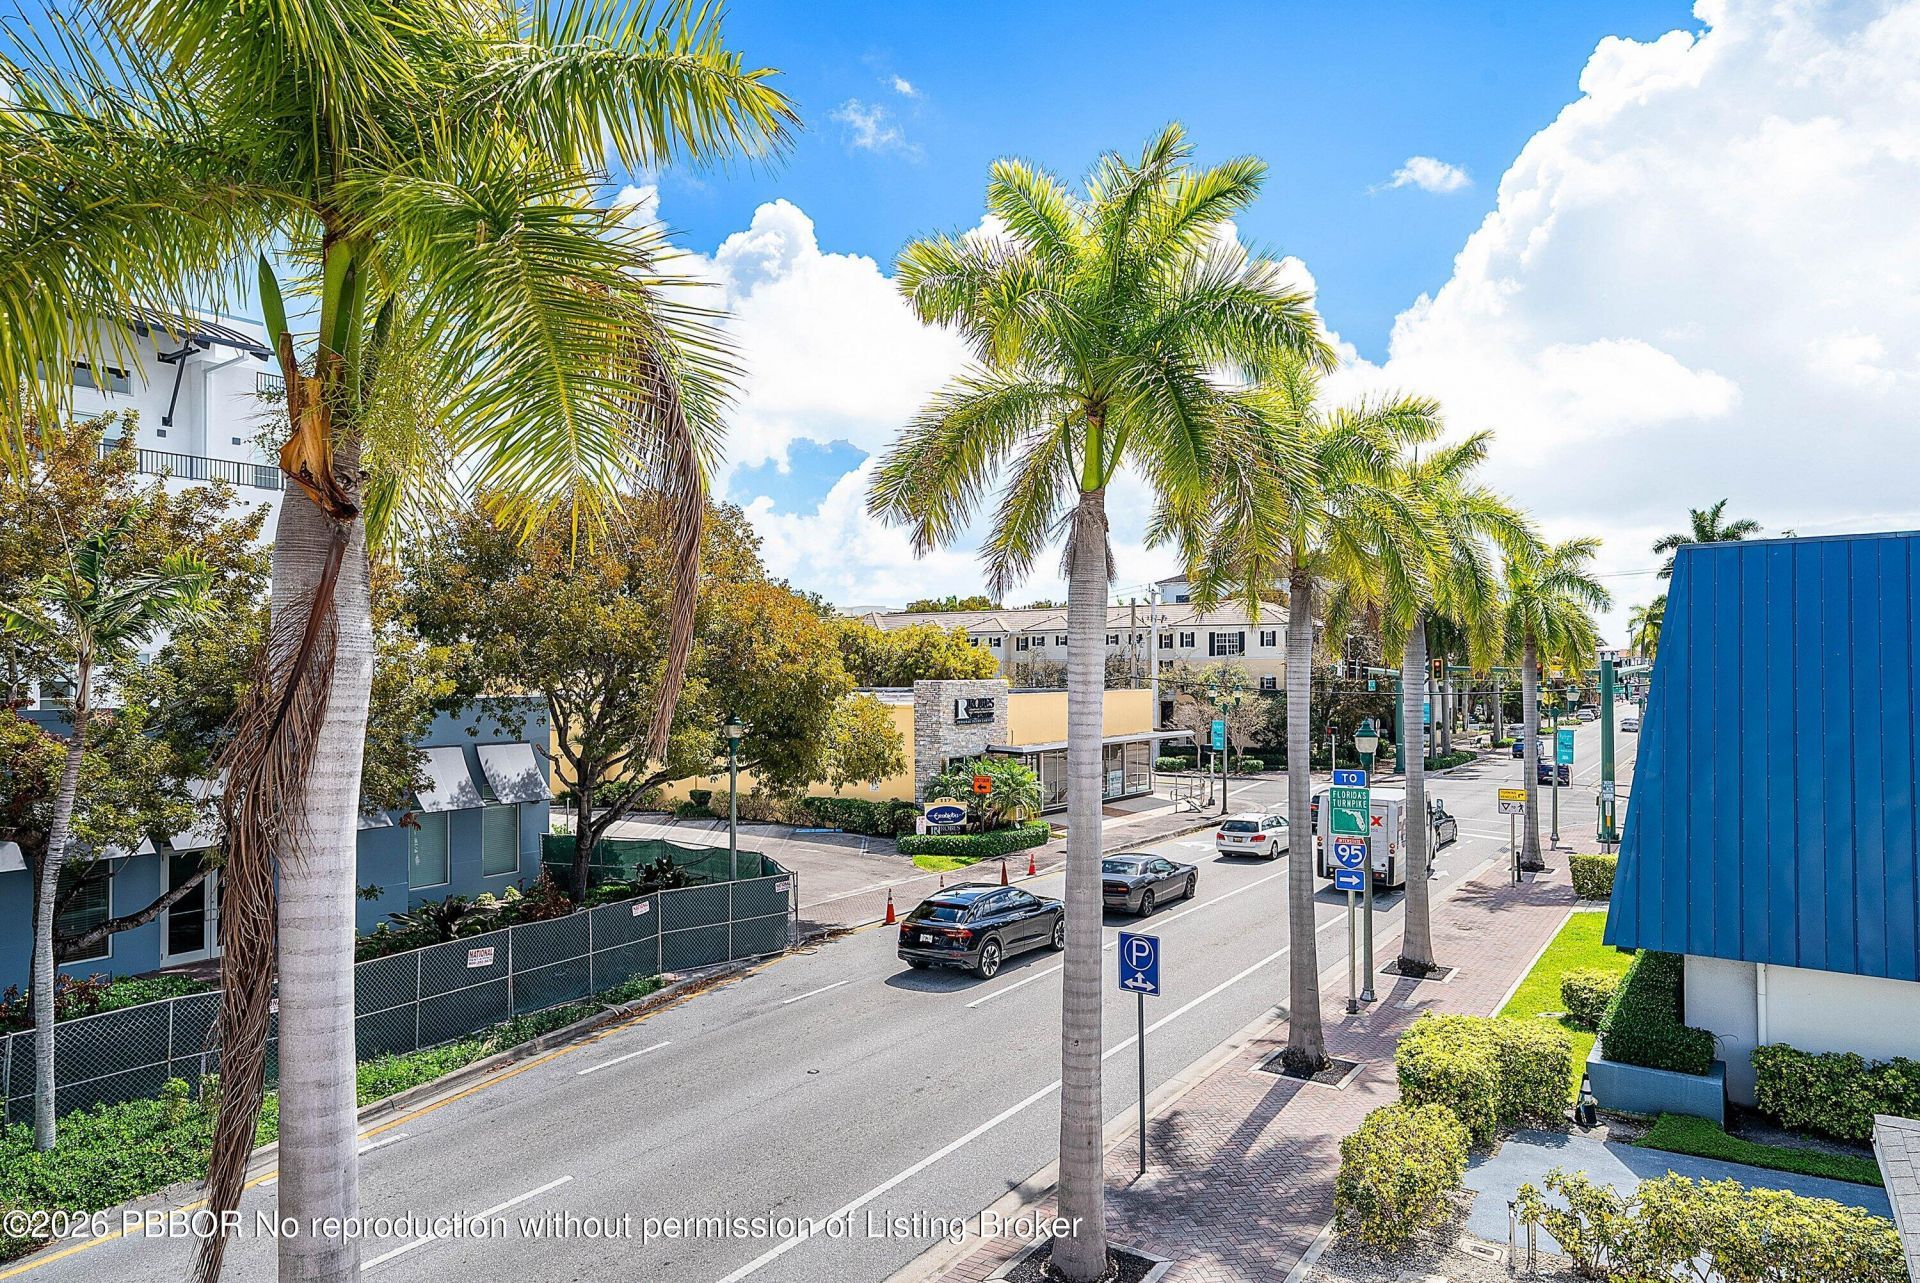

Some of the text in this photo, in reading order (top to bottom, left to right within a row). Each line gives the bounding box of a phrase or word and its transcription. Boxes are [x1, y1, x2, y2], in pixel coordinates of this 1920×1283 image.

[1342, 773, 1357, 783] TO
[1332, 790, 1367, 800] FLORIDA'S
[1332, 799, 1367, 809] TURNPIKE
[1337, 845, 1363, 863] 95
[470, 948, 493, 957] NATIONAL
[1132, 940, 1150, 966] P
